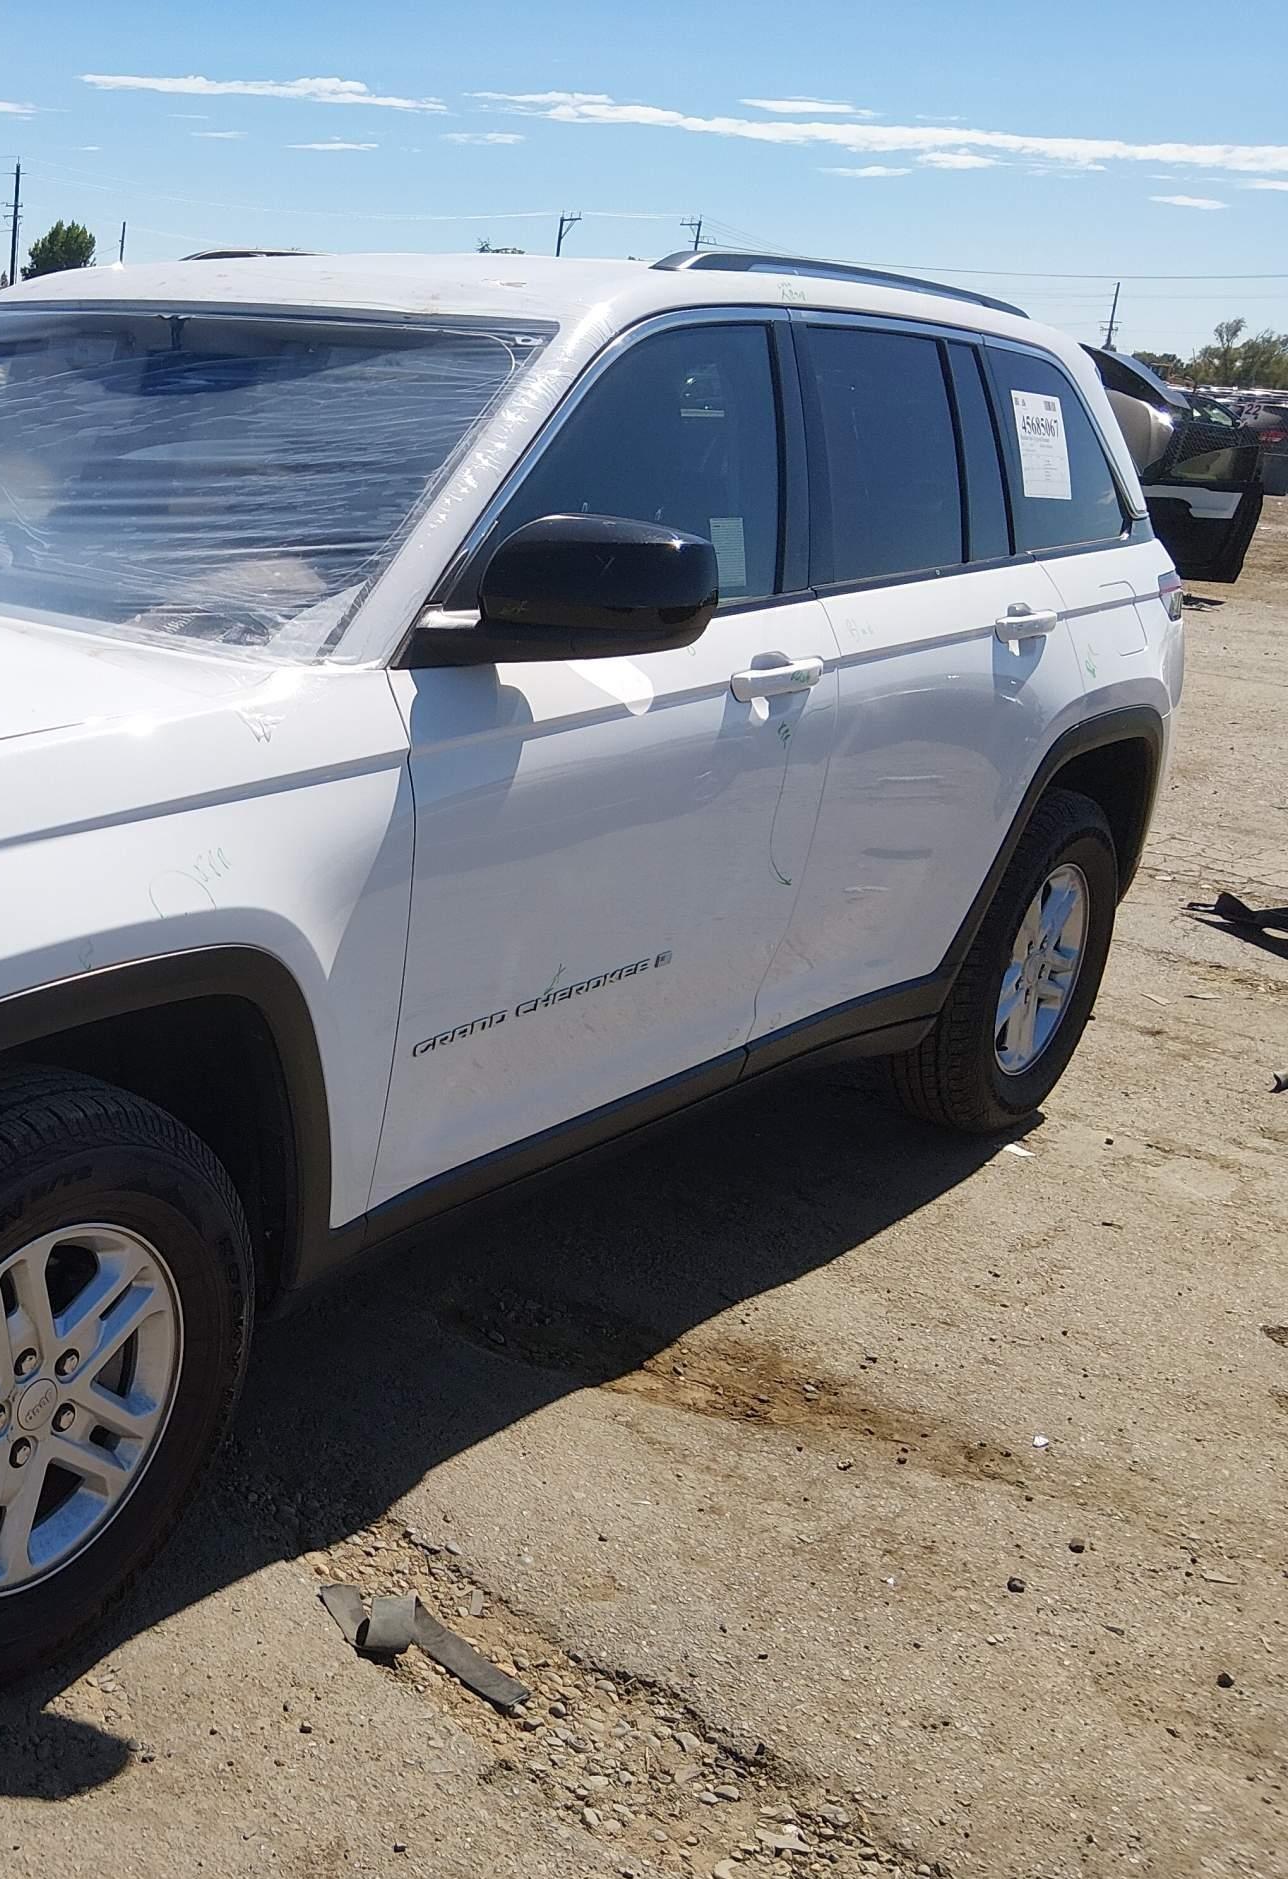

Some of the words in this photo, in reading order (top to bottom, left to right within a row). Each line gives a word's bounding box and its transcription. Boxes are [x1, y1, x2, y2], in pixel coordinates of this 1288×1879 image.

[1021, 415, 1059, 439] 45685067
[412, 1009, 508, 1058] GRAND
[515, 958, 651, 1017] CHEROKEE
